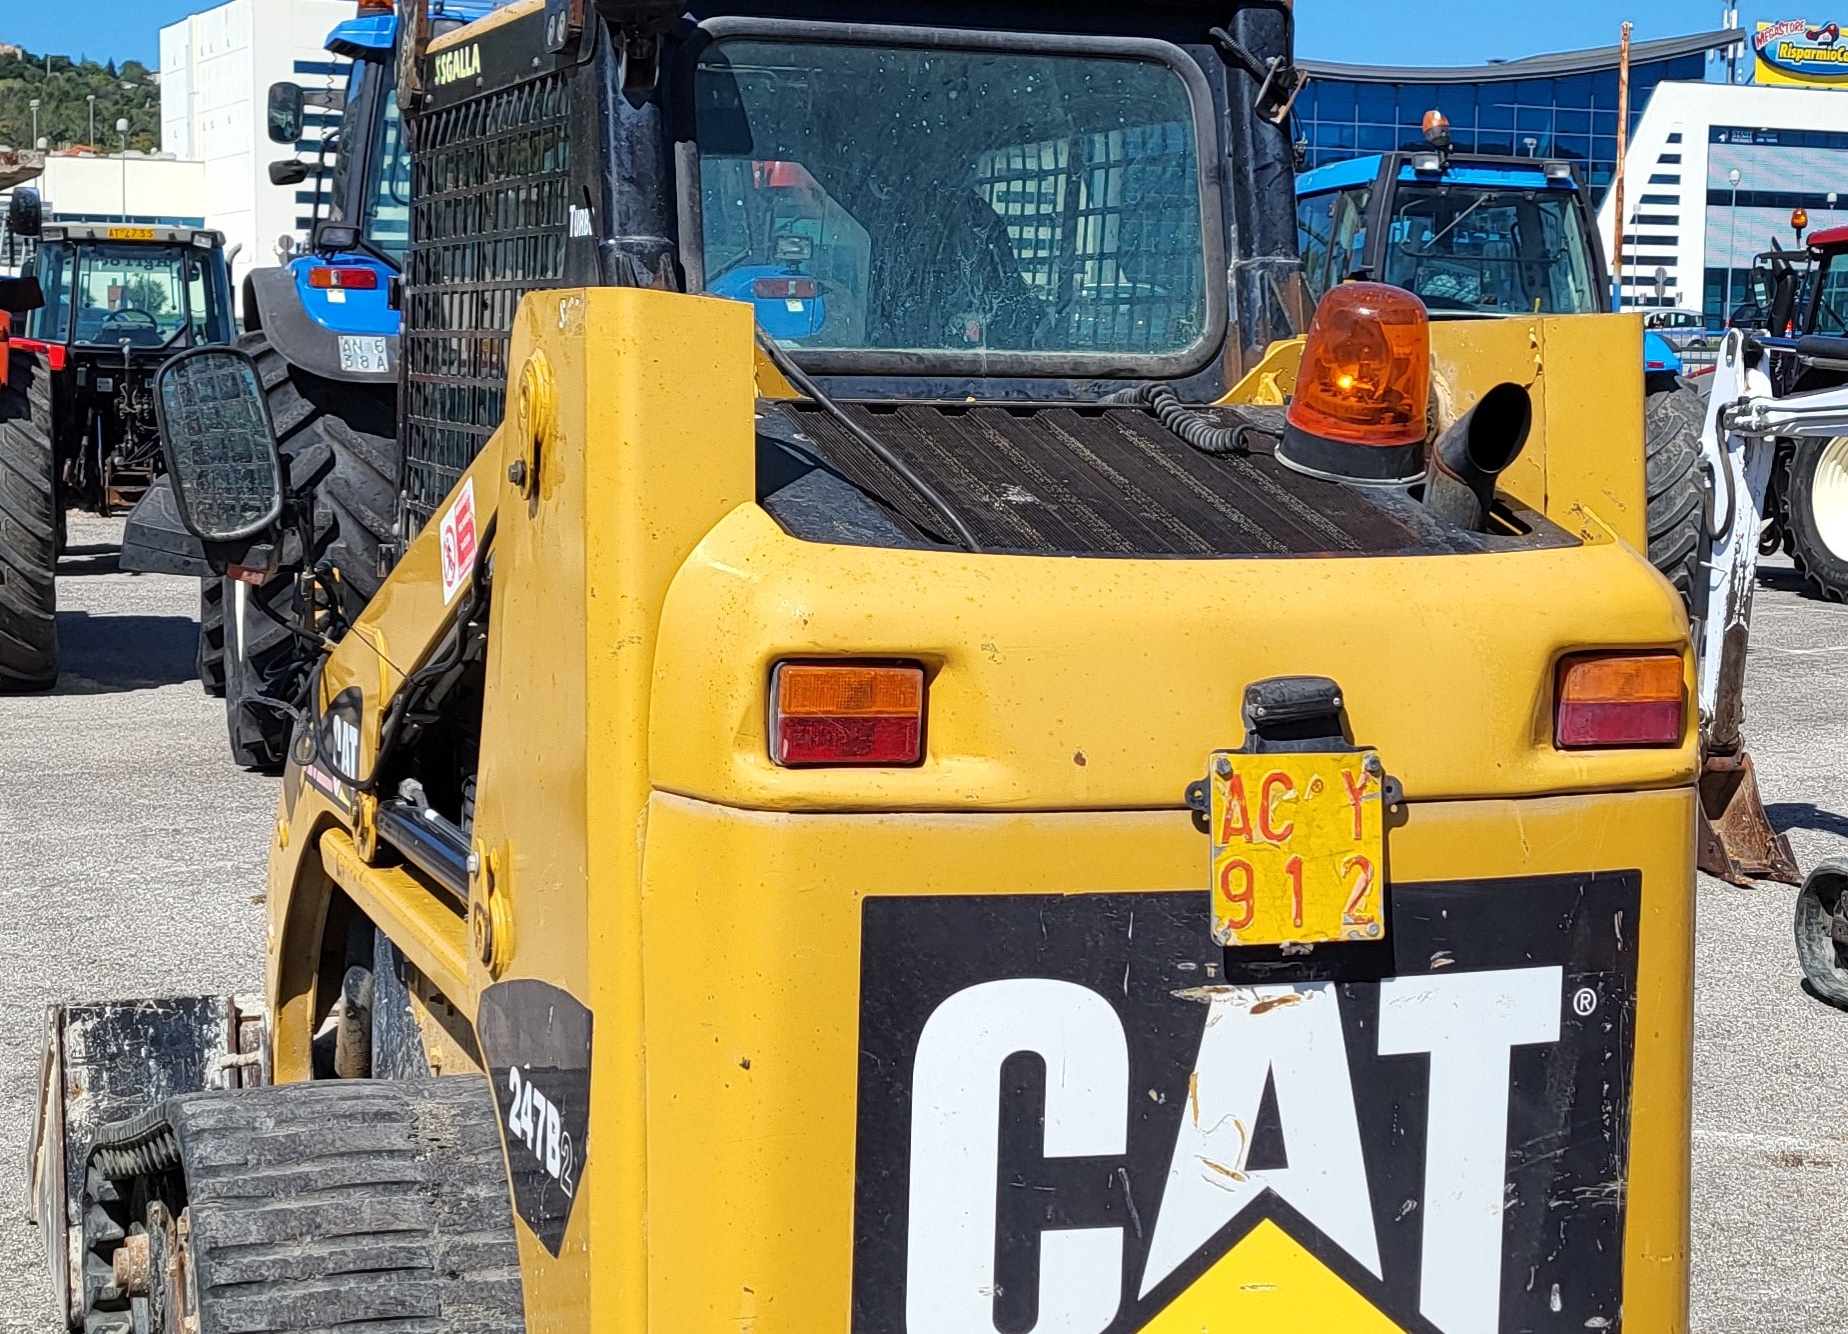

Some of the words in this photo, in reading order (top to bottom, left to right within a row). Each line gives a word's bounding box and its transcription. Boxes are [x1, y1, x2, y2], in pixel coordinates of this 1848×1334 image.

[342, 338, 363, 354] AN
[1221, 771, 1294, 844] AC
[1342, 770, 1371, 840] Y
